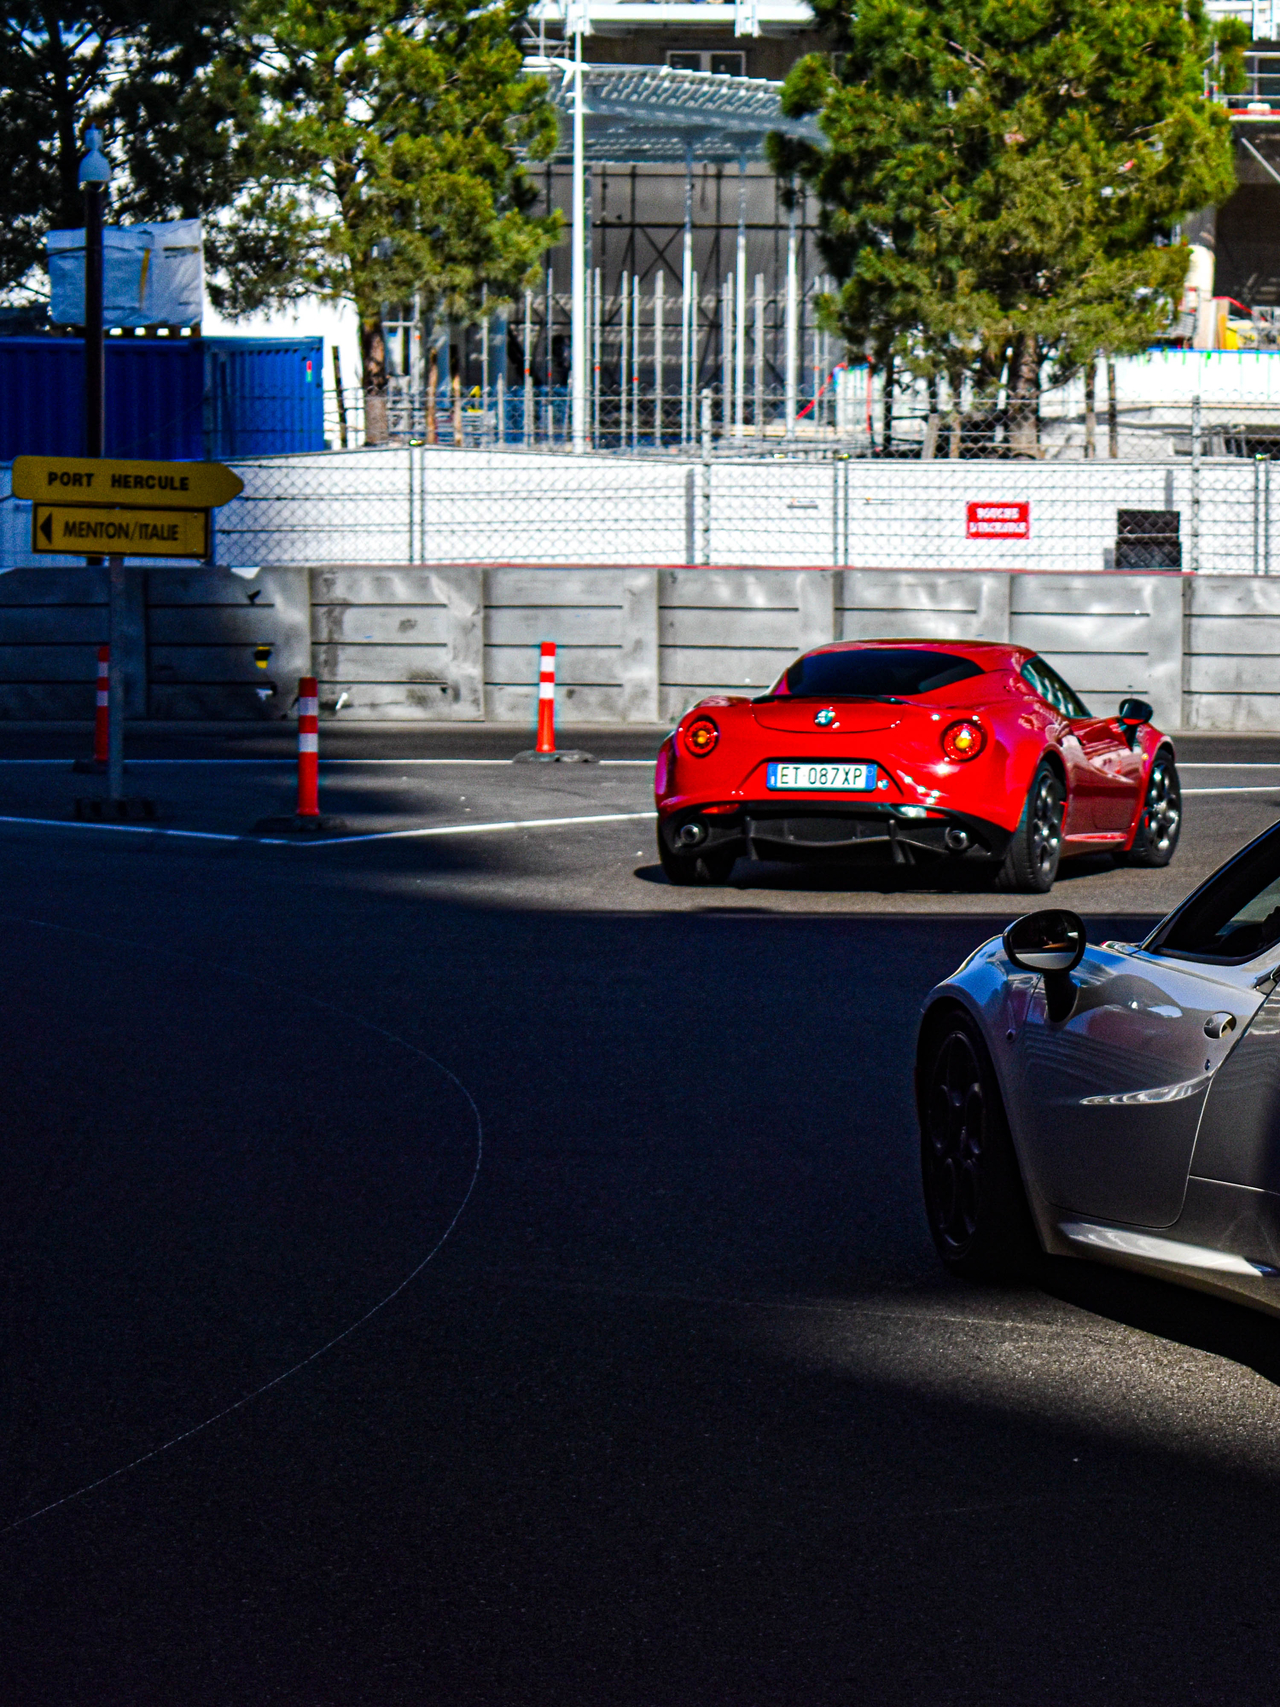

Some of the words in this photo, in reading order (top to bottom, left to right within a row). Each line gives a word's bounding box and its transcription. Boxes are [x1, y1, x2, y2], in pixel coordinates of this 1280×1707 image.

[48, 471, 94, 487] PORT
[111, 474, 190, 491] HERCULE
[63, 520, 179, 541] MENTON/ITALIE
[780, 766, 801, 785] ET
[808, 767, 863, 785] 087XP
